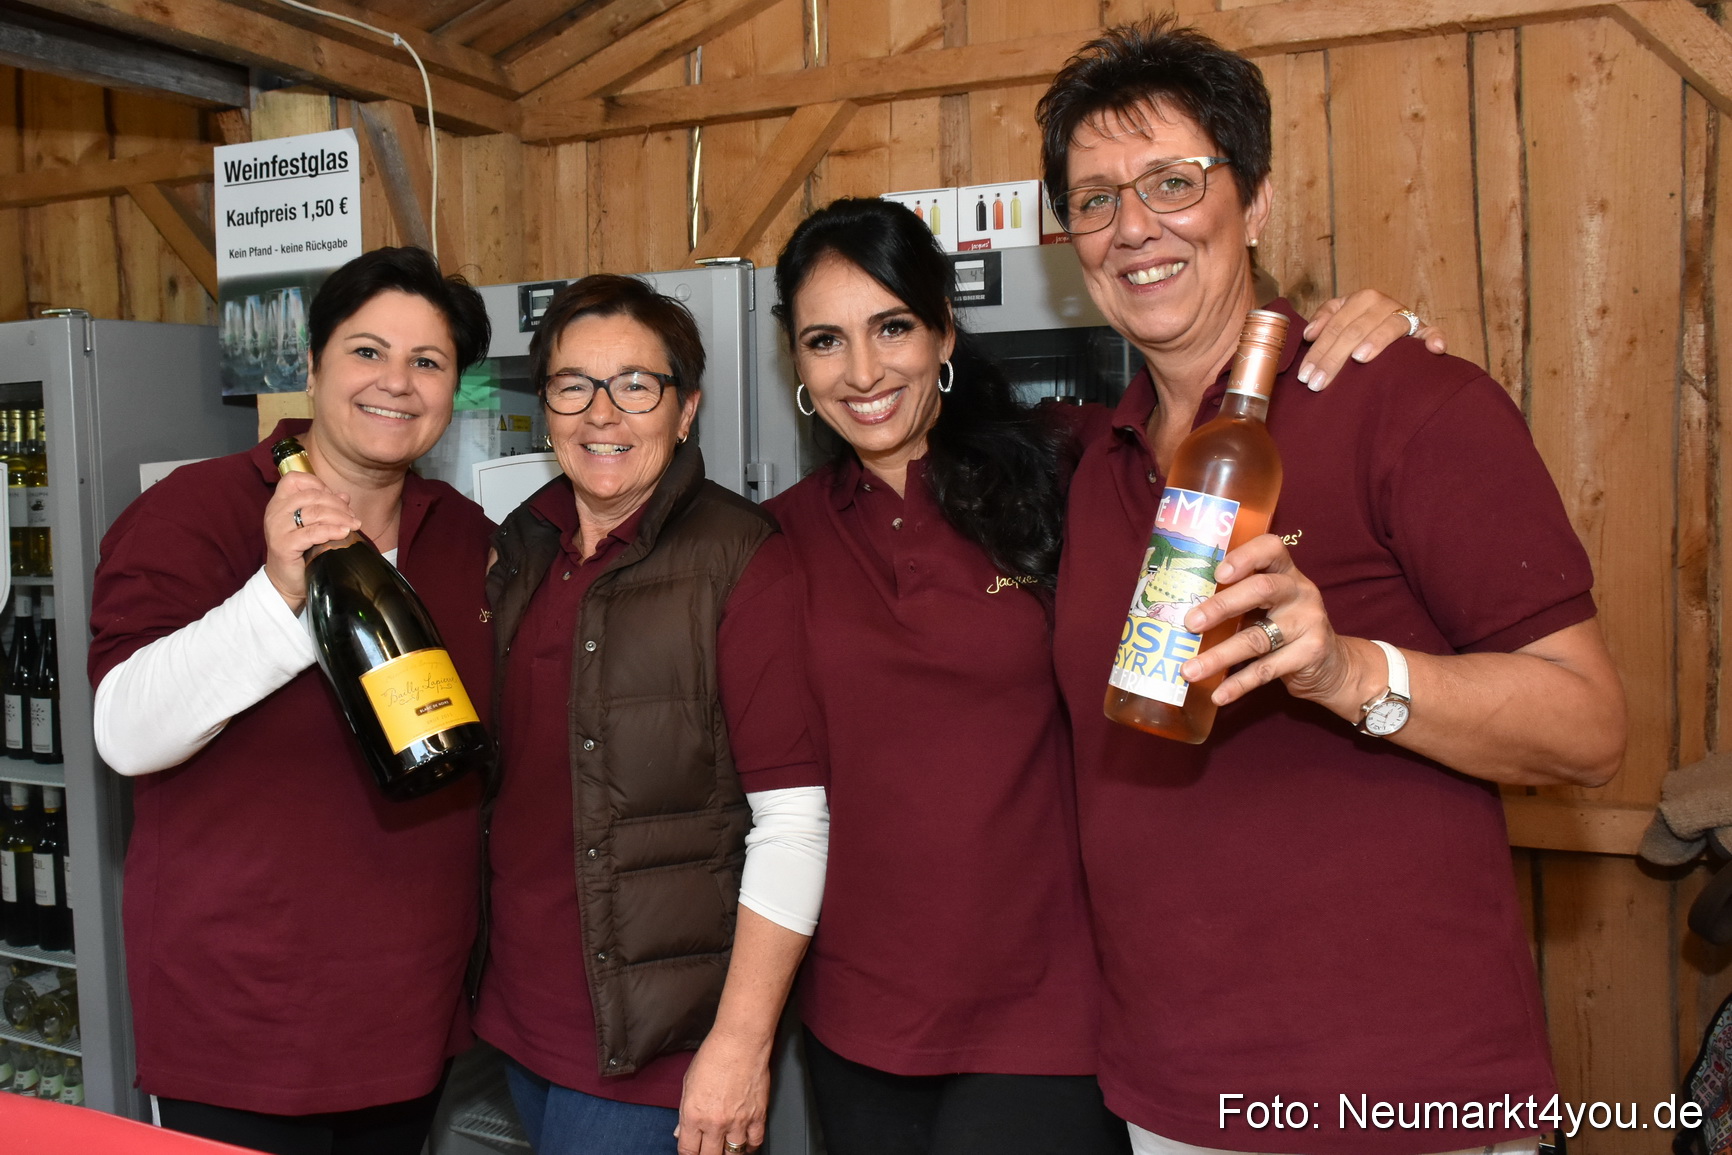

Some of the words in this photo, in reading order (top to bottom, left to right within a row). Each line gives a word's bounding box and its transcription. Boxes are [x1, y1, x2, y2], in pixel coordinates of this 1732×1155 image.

[223, 148, 349, 183] Weinfestglas
[226, 203, 297, 228] Kaufpreis
[302, 198, 334, 221] 1,50
[339, 197, 348, 215] €
[229, 248, 247, 259] Kein
[249, 245, 272, 257] Pfand
[280, 243, 303, 254] keine
[305, 238, 348, 252] Rückgabe
[1172, 490, 1235, 537] MAS
